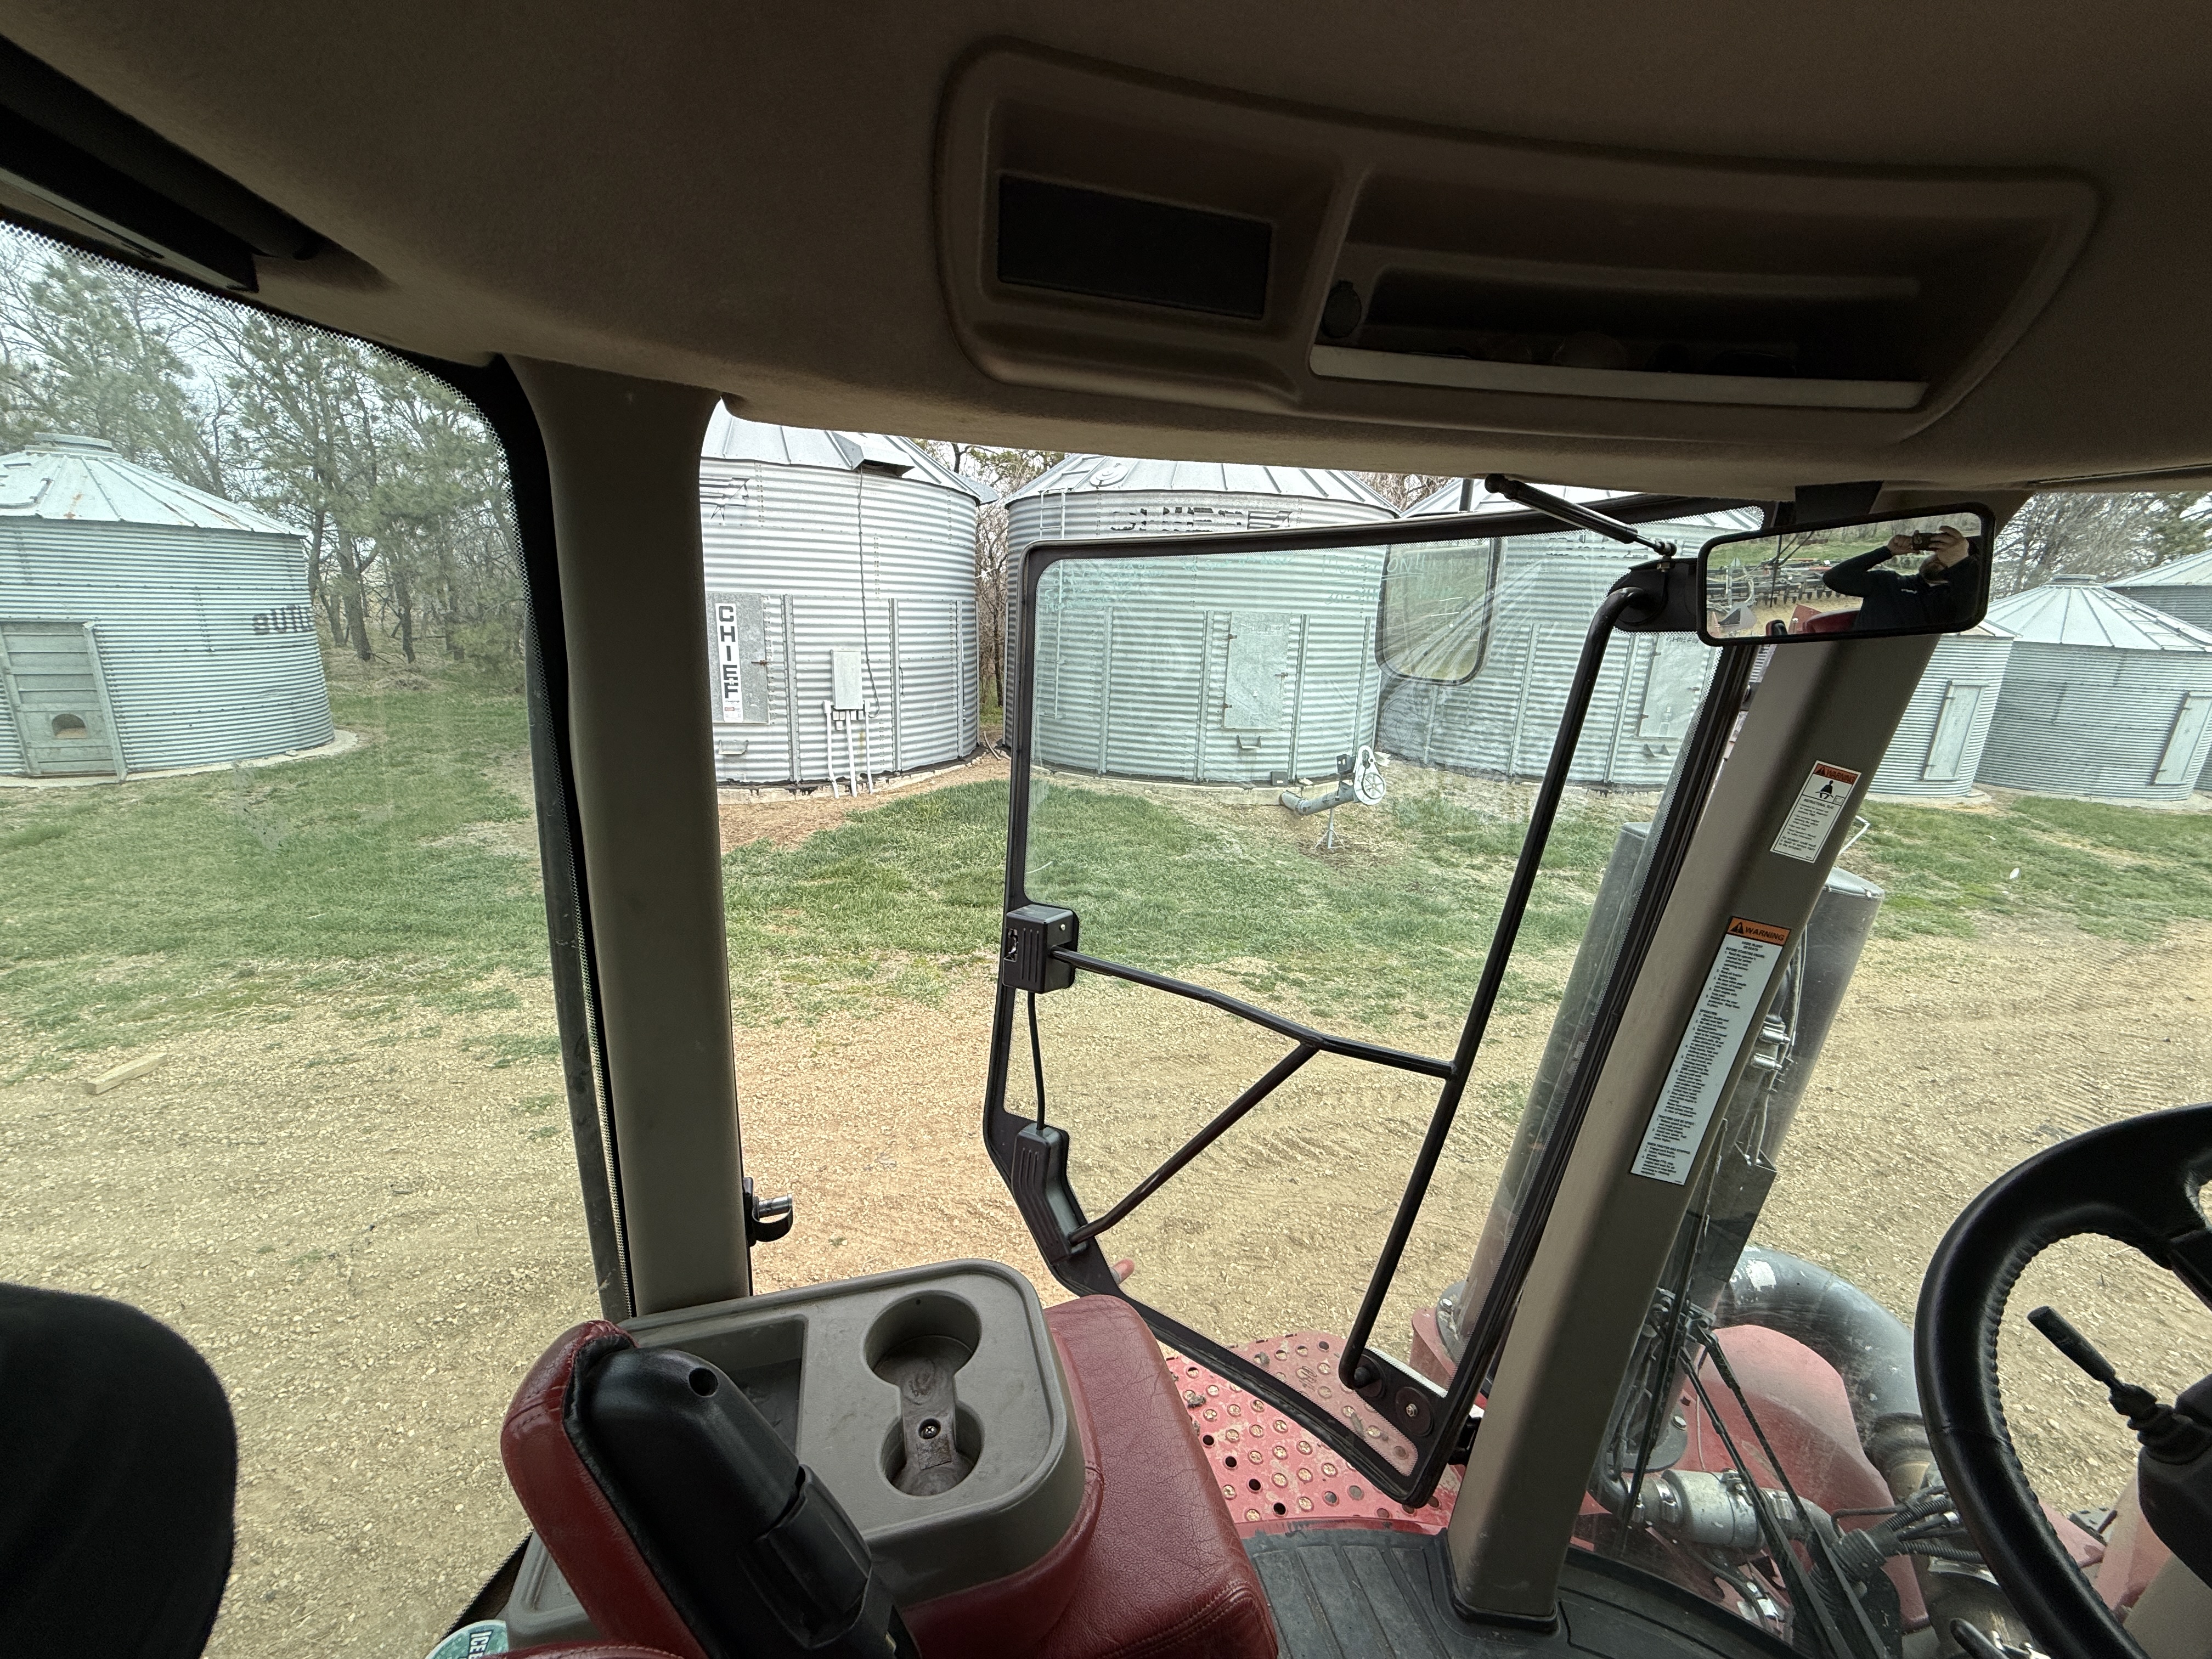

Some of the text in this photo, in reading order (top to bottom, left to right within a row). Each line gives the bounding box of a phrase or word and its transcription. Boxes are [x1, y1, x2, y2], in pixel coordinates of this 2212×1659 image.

[719, 606, 739, 698] CHIEF
[1825, 769, 1855, 783] WARNING
[1745, 926, 1785, 941] WARNING
